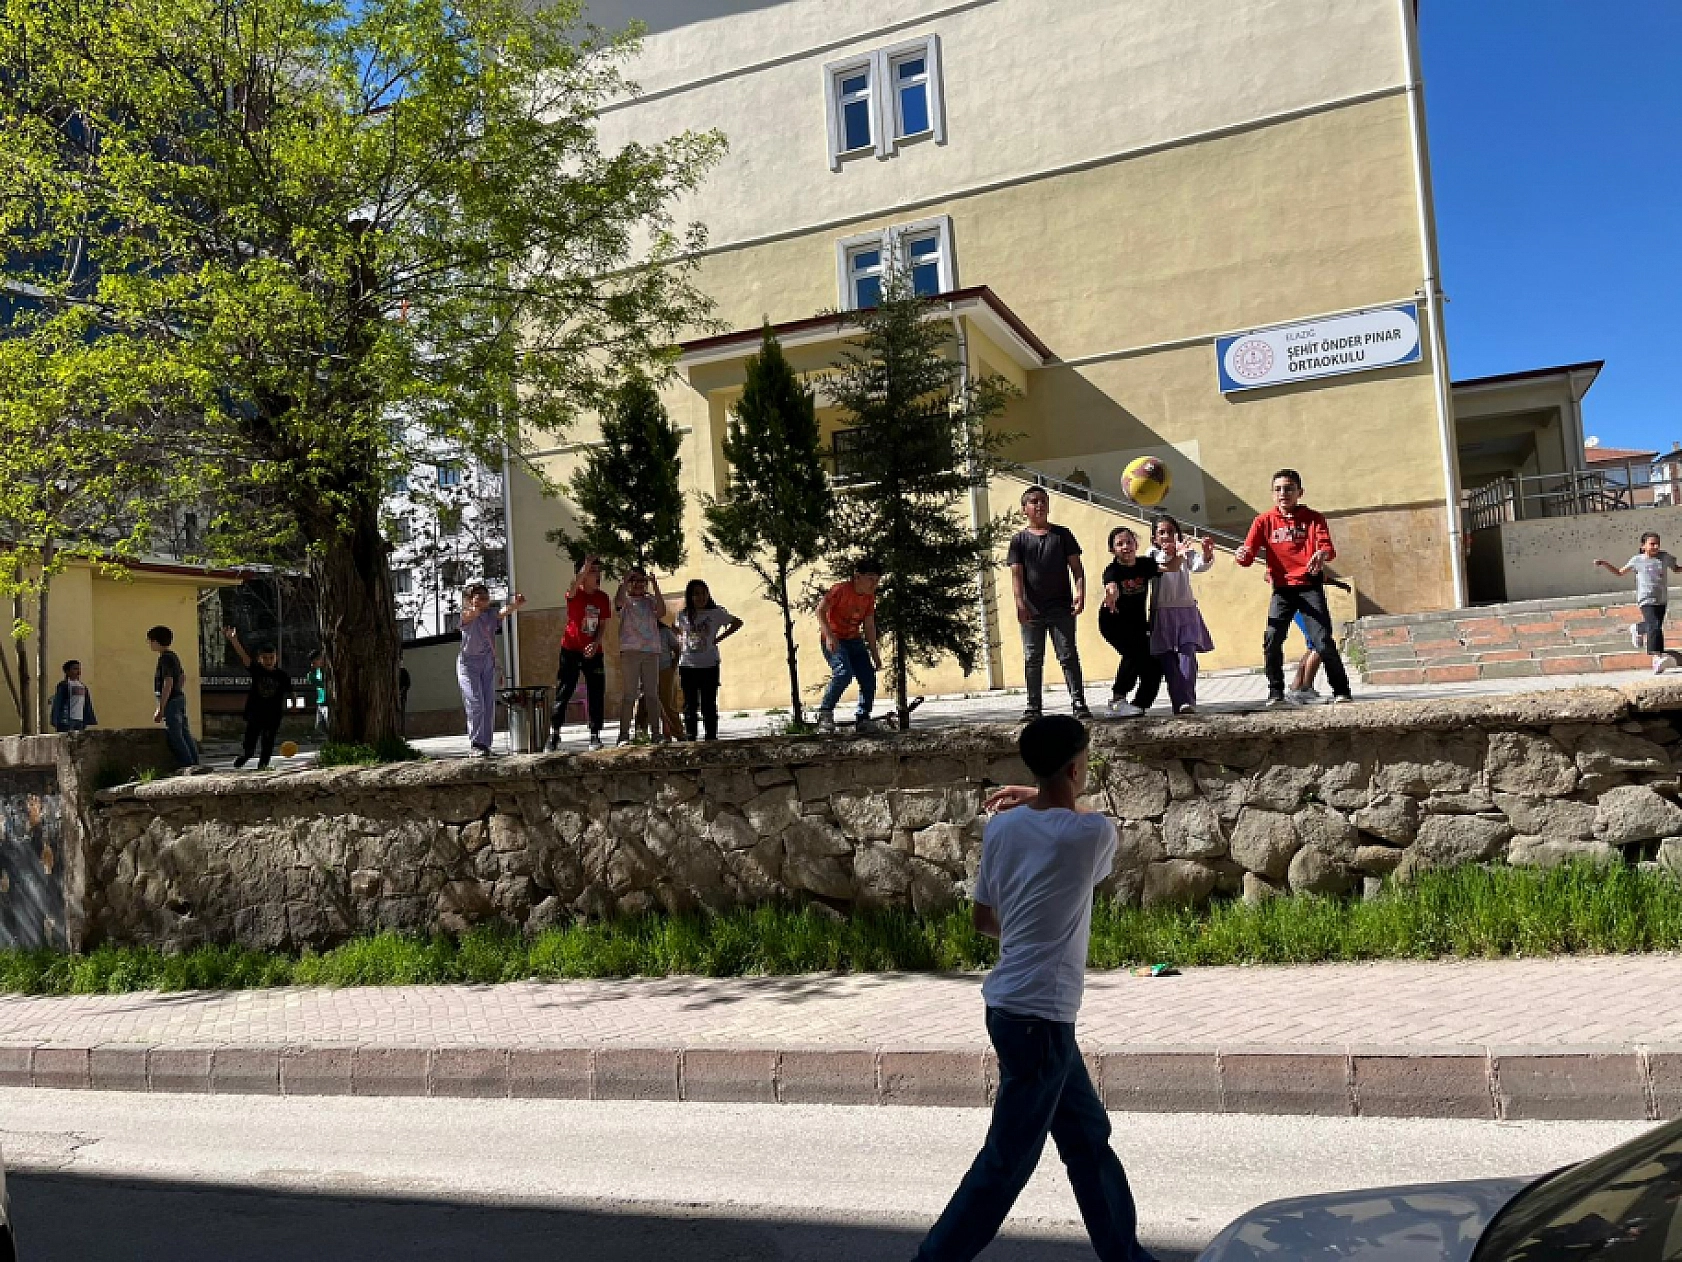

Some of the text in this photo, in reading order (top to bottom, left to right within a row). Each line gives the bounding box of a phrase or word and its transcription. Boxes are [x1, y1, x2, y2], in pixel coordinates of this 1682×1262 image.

[1288, 341, 1319, 360] ŞEHİT
[1321, 337, 1362, 351] ÖNDER
[1365, 329, 1401, 345] PINAR
[1288, 350, 1364, 372] ORTAOKULU
